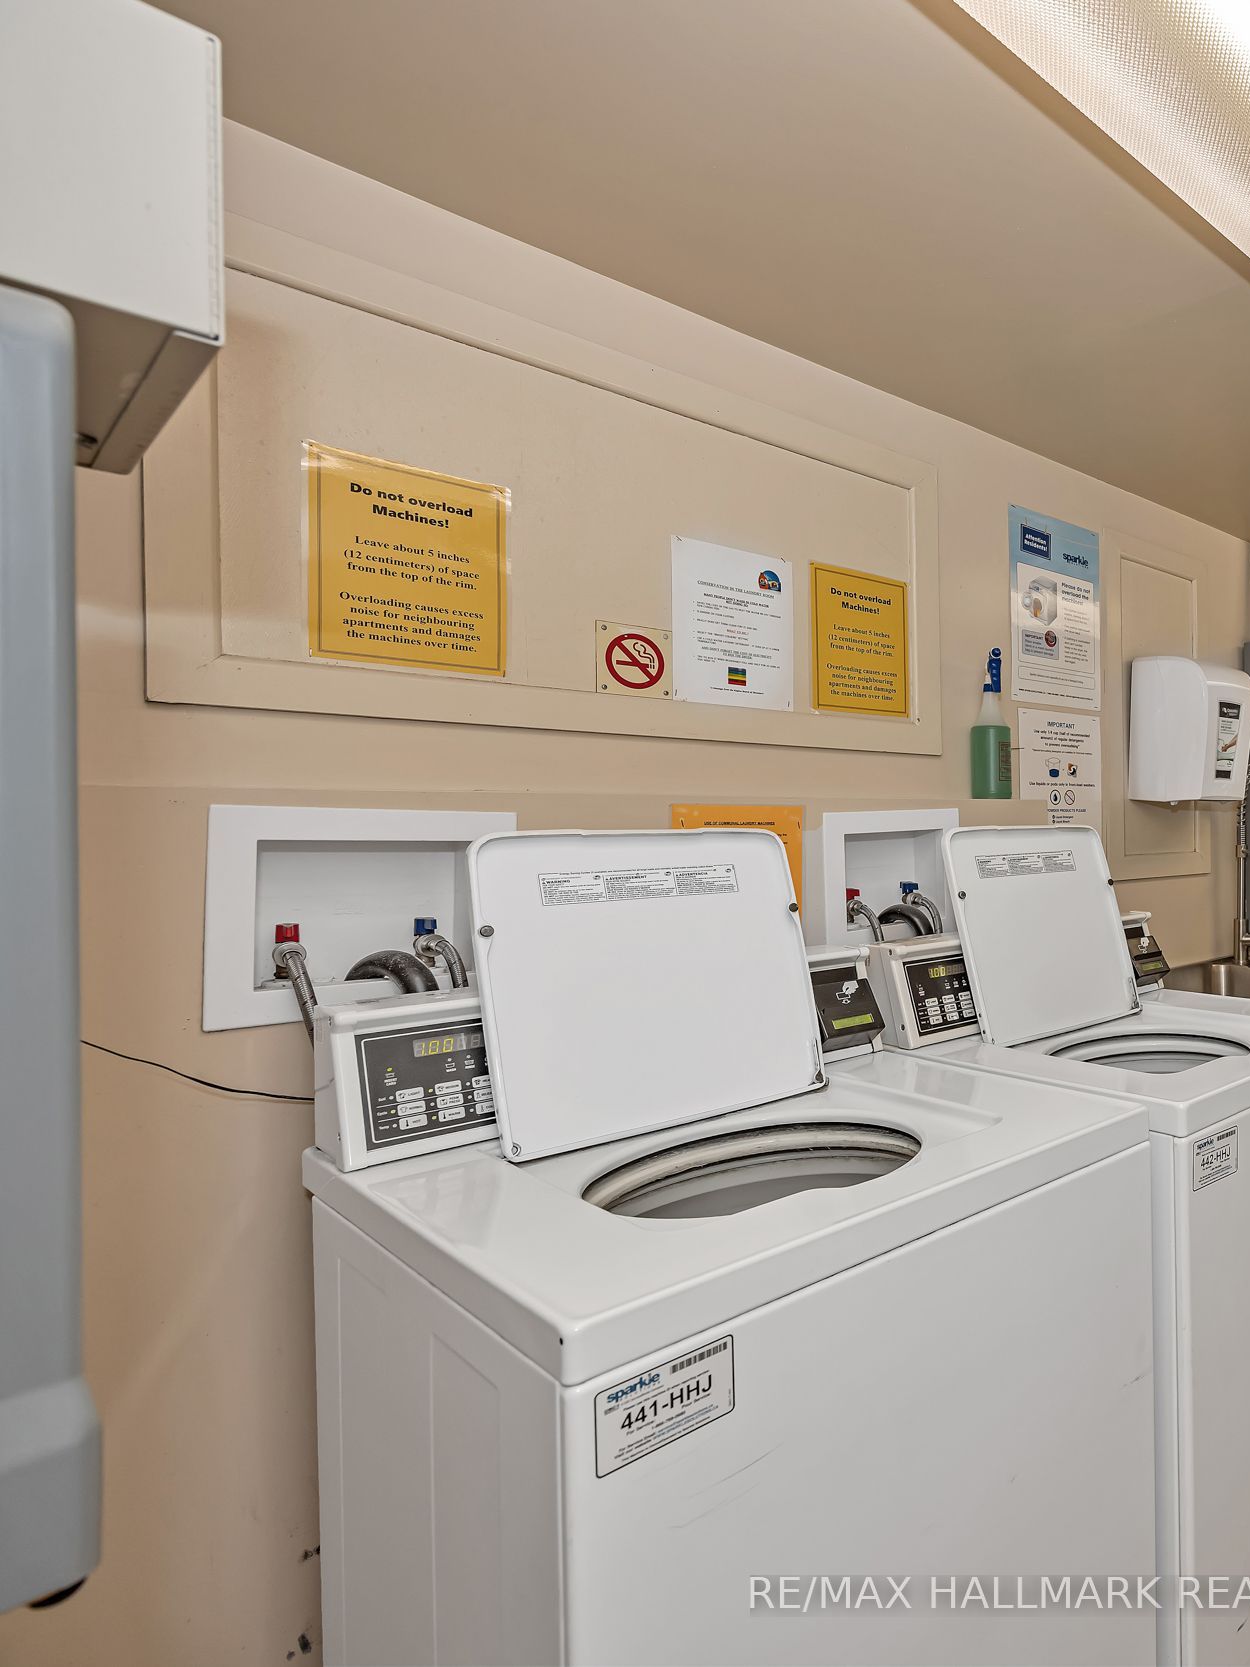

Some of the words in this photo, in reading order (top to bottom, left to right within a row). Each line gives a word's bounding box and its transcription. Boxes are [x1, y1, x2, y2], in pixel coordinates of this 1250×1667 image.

[350, 482, 372, 496] Do
[377, 490, 404, 502] not
[409, 496, 473, 518] overload
[372, 504, 450, 528] Machines!
[355, 536, 389, 550] Leave
[393, 542, 424, 556] about
[428, 549, 434, 557] 5
[438, 550, 470, 564] inches
[1063, 553, 1088, 566] sparkle
[344, 549, 362, 560] (12
[366, 552, 435, 573] centimeters)
[438, 565, 450, 574] of
[452, 569, 480, 580] space
[347, 561, 376, 575] from
[380, 565, 397, 578] the
[401, 570, 419, 582] top
[422, 574, 434, 583] of
[436, 576, 452, 587] the
[456, 580, 477, 591] rim.
[340, 591, 412, 611] Overloading
[415, 603, 449, 615] causes
[452, 609, 484, 620] excess
[831, 587, 841, 596] Do
[844, 591, 856, 599] not
[859, 594, 891, 606] overload
[842, 601, 880, 614] Machines!
[350, 605, 379, 618] noise
[383, 609, 400, 619] for
[403, 612, 475, 631] neighbouring
[834, 624, 850, 632] Leave
[343, 617, 409, 633] apartments
[412, 625, 432, 636] and
[435, 628, 481, 642] damages
[347, 628, 365, 639] the
[368, 632, 421, 646] machines
[424, 639, 448, 648] over
[451, 640, 477, 653] time.
[830, 642, 844, 650] from
[846, 644, 855, 652] the
[839, 636, 873, 646] centimeters)
[827, 662, 862, 674] Overloading
[829, 681, 860, 690] apartments
[874, 685, 896, 694] damages
[858, 675, 893, 686] neighbouring
[841, 690, 867, 698] machines
[1201, 1147, 1230, 1167] 442-HHJ
[607, 1373, 660, 1403] sparkle
[621, 1374, 712, 1430] 441-HHJ
